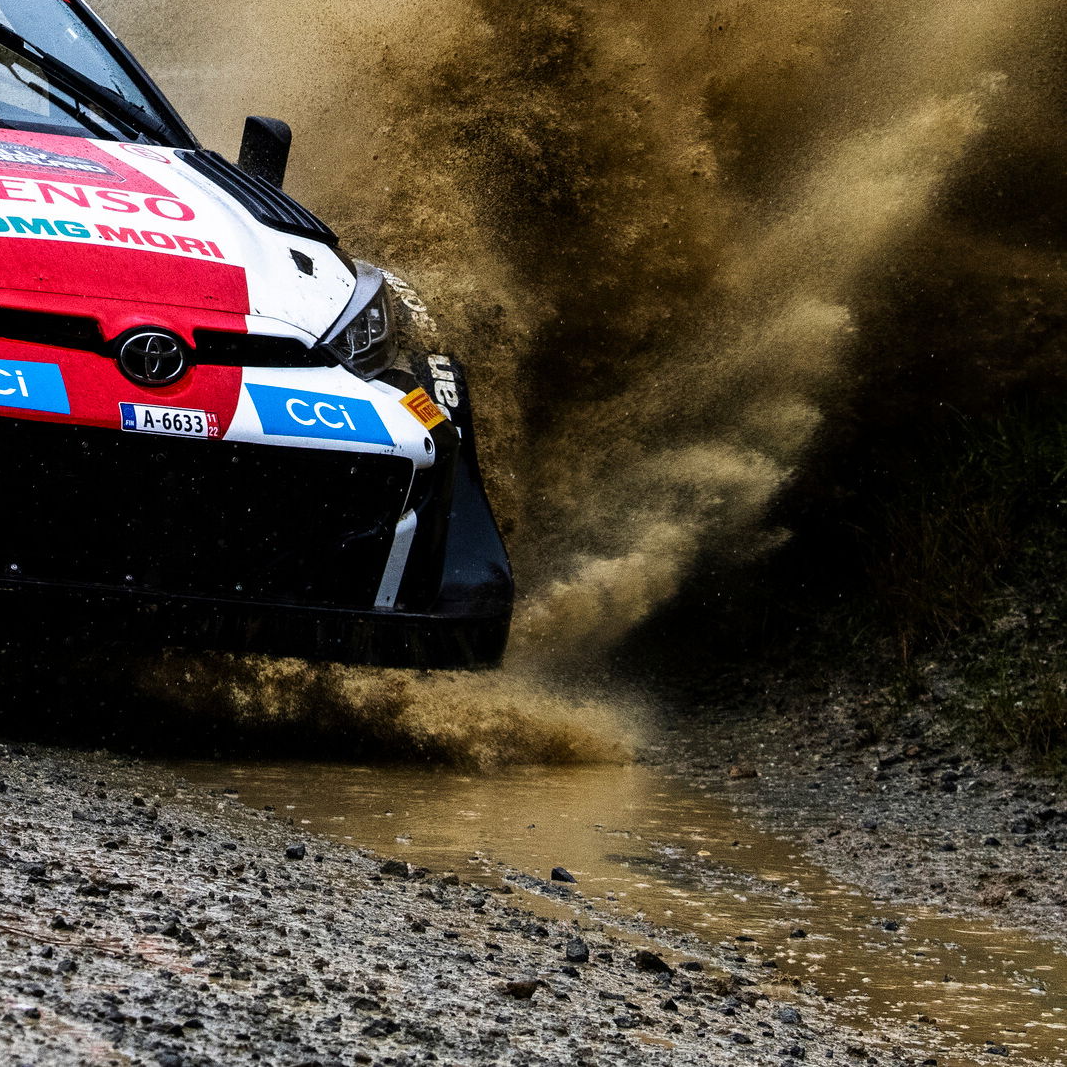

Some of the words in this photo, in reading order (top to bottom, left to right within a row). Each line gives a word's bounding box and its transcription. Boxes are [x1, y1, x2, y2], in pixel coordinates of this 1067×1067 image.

[94, 224, 226, 260] MORI
[143, 409, 204, 433] A-6633
[206, 414, 217, 423] 11
[208, 426, 218, 437] 22
